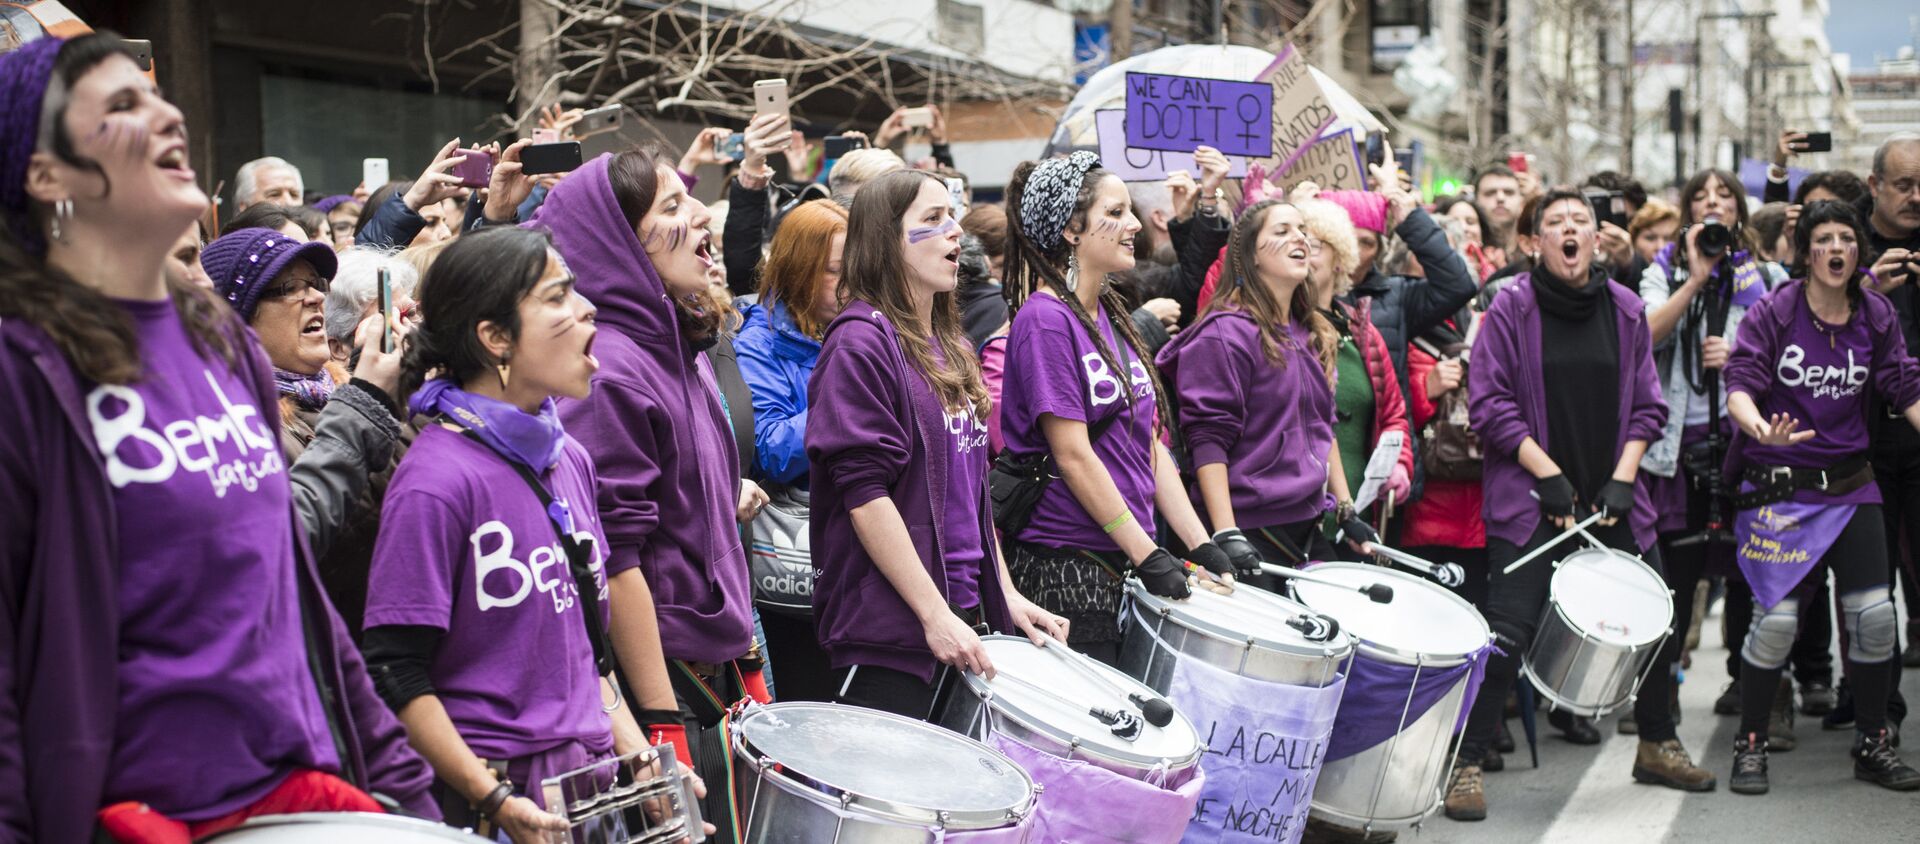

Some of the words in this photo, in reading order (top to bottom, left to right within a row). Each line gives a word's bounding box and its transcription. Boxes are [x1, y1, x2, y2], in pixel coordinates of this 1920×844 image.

[1131, 76, 1160, 99] WE
[1168, 78, 1211, 102] CAN
[1206, 720, 1246, 761] LA
[1222, 799, 1294, 843] NOCHE
